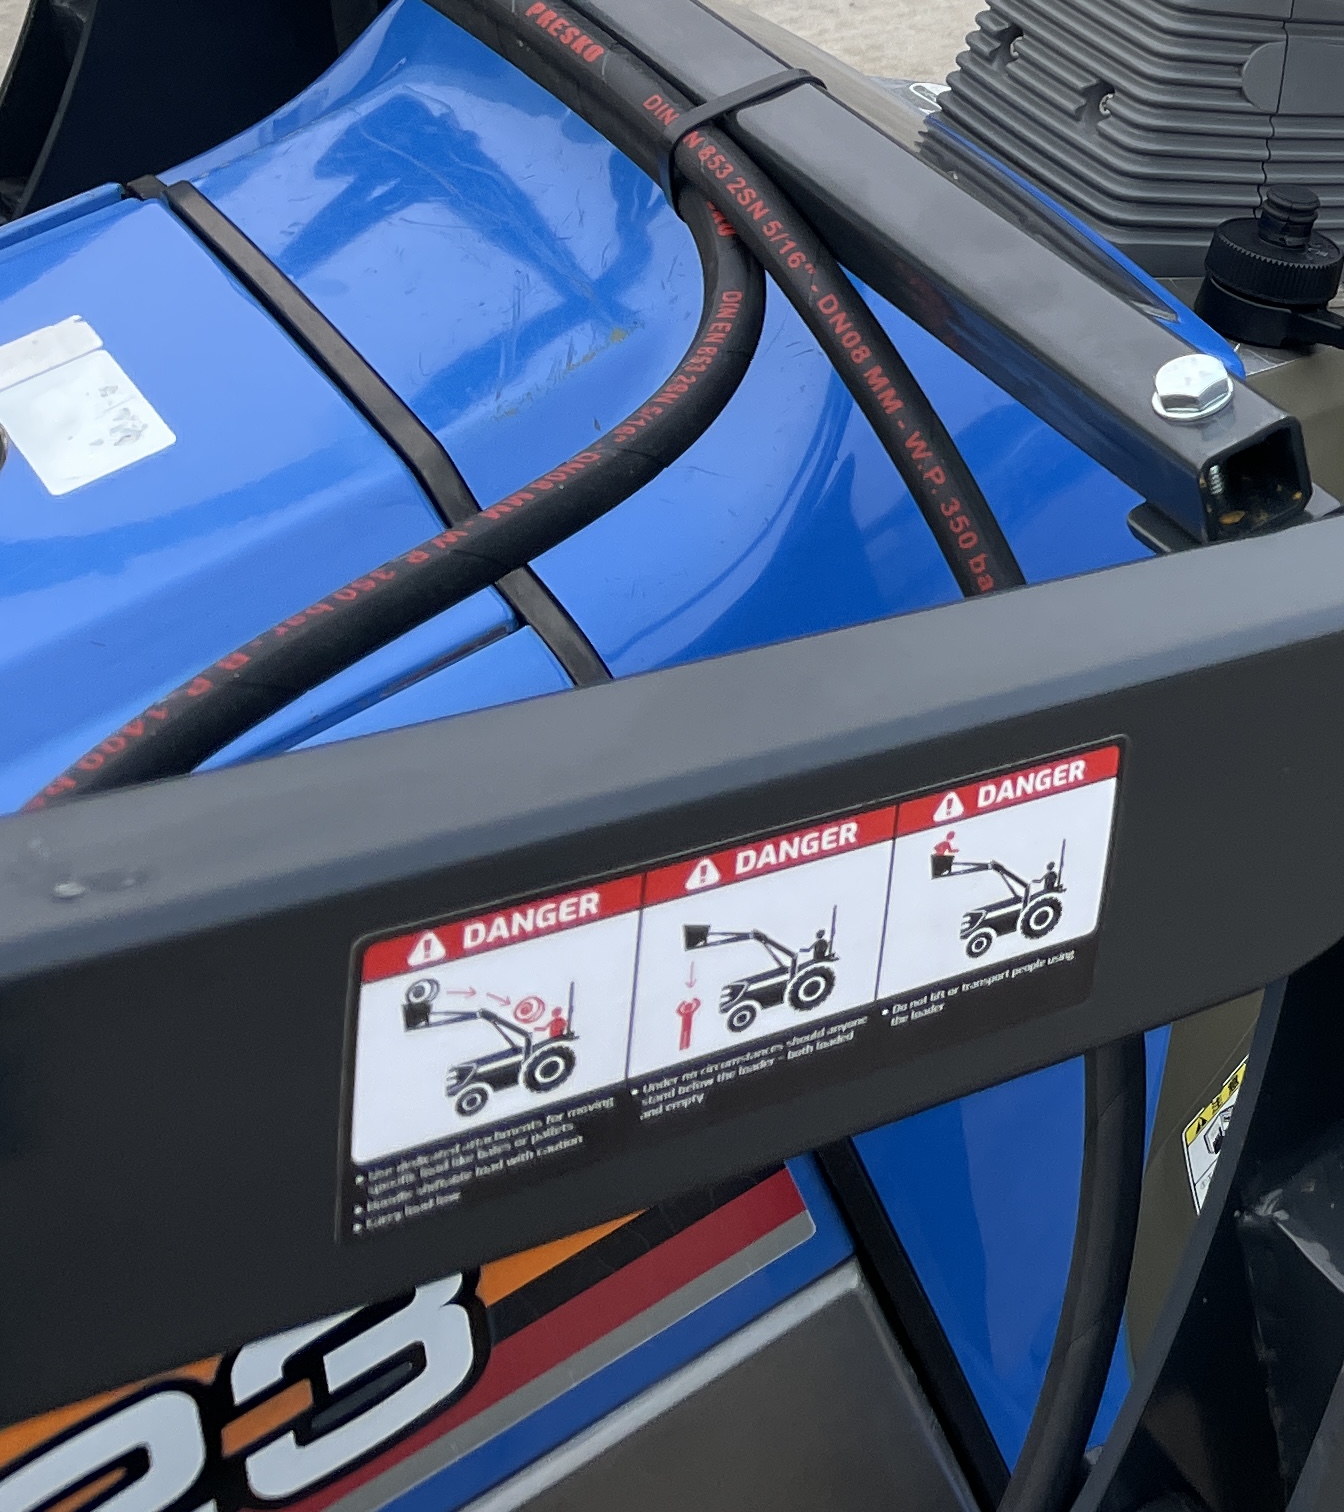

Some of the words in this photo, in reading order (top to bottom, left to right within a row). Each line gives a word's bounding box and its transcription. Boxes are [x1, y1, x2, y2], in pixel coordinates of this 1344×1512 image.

[525, 1, 605, 63] PRESKO
[642, 94, 680, 127] DIN
[698, 145, 735, 180] 853
[726, 176, 770, 221] 2SN
[762, 220, 817, 275] 5/16"
[817, 293, 872, 364] DN08
[863, 365, 904, 415] MM
[905, 430, 947, 496] W.P.
[940, 496, 979, 550] 350
[715, 291, 743, 319] DIN
[702, 322, 733, 344] EN
[652, 375, 697, 404] 2SN
[479, 491, 536, 520] MM
[977, 759, 1086, 808] DANGER
[734, 822, 858, 874] DANGER
[462, 892, 600, 949] DANGER
[892, 1003, 908, 1014] Do
[910, 996, 928, 1010] not
[930, 989, 946, 1002] lift
[961, 969, 1010, 992] transport
[1011, 958, 1046, 979] people
[1048, 949, 1076, 966] using
[890, 1014, 909, 1027] the
[911, 1002, 946, 1020] loader
[642, 1076, 679, 1094] Under
[786, 1027, 825, 1048] should
[827, 1015, 869, 1036] anyone
[678, 1077, 715, 1095] below
[717, 1069, 737, 1083] the
[738, 1058, 775, 1076] loader
[787, 1045, 814, 1061] both
[665, 1092, 705, 1113] empty
